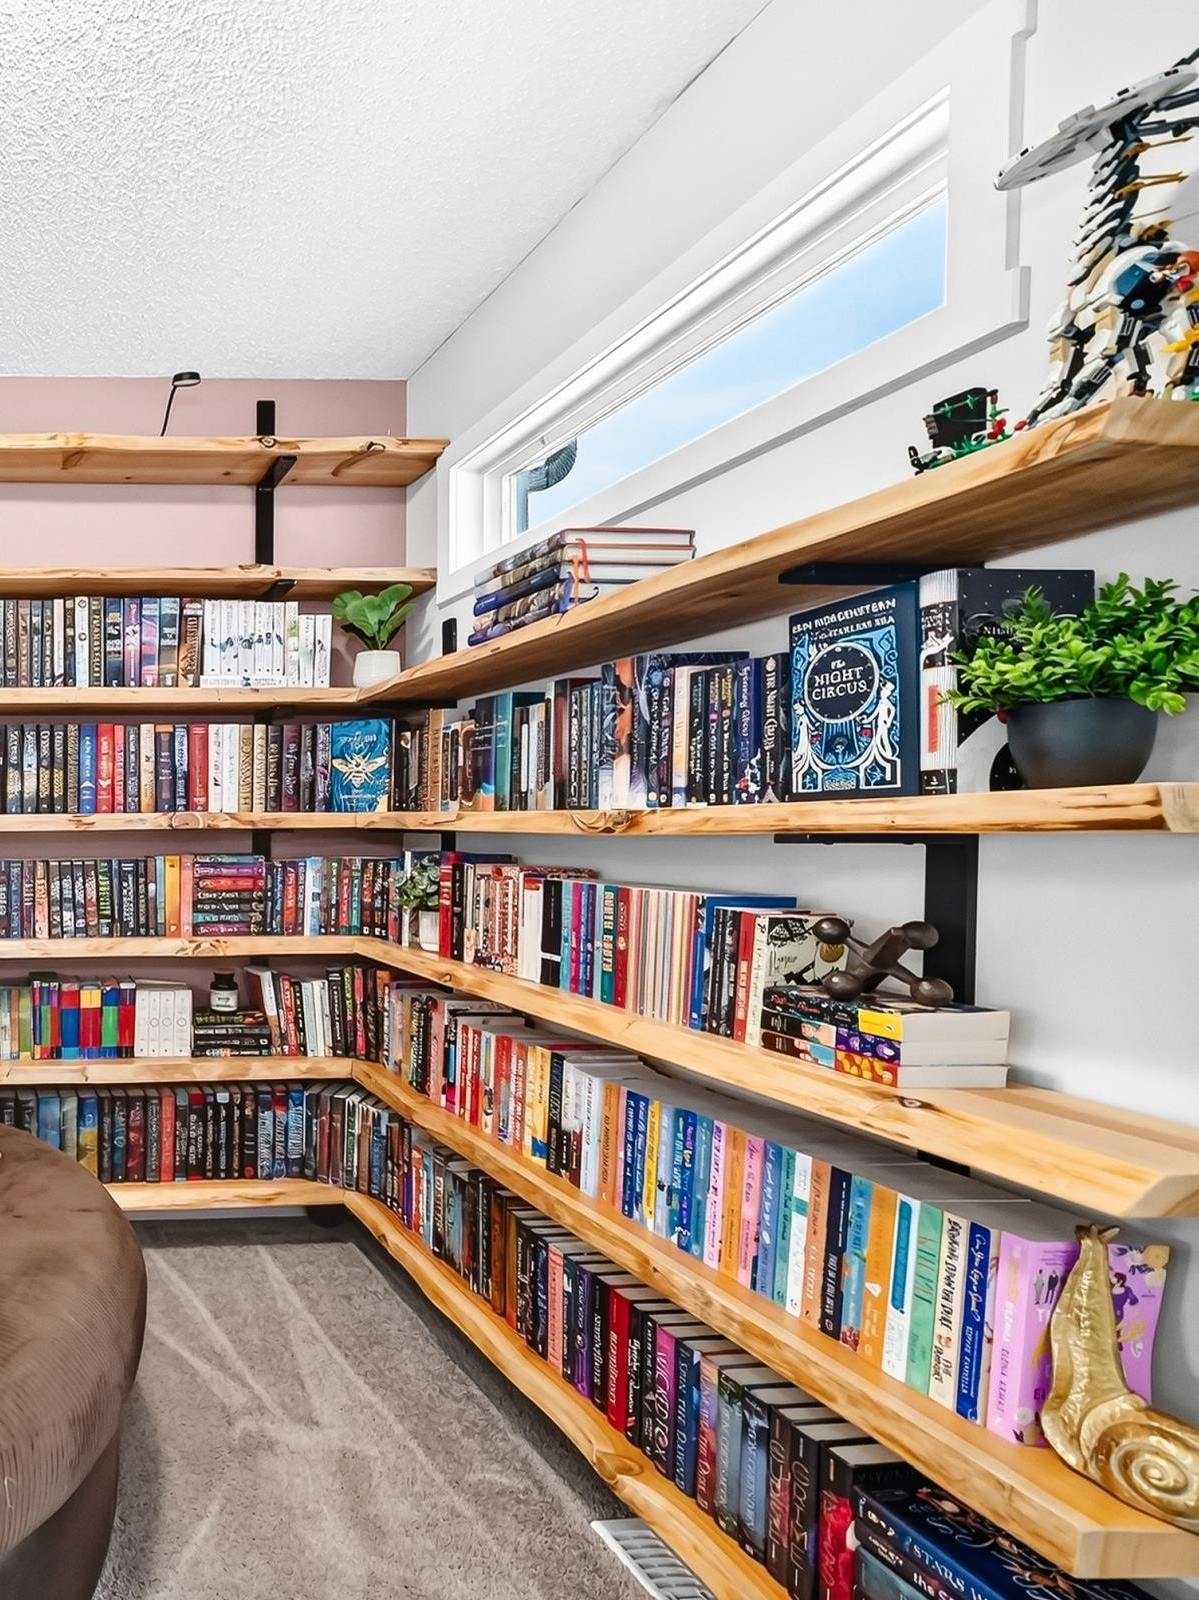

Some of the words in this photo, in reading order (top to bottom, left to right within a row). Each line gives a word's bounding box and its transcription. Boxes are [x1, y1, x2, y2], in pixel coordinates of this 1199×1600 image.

[813, 666, 864, 687] NIGHT
[811, 680, 868, 701] CIRCUS
[913, 1545, 965, 1593] STARS
